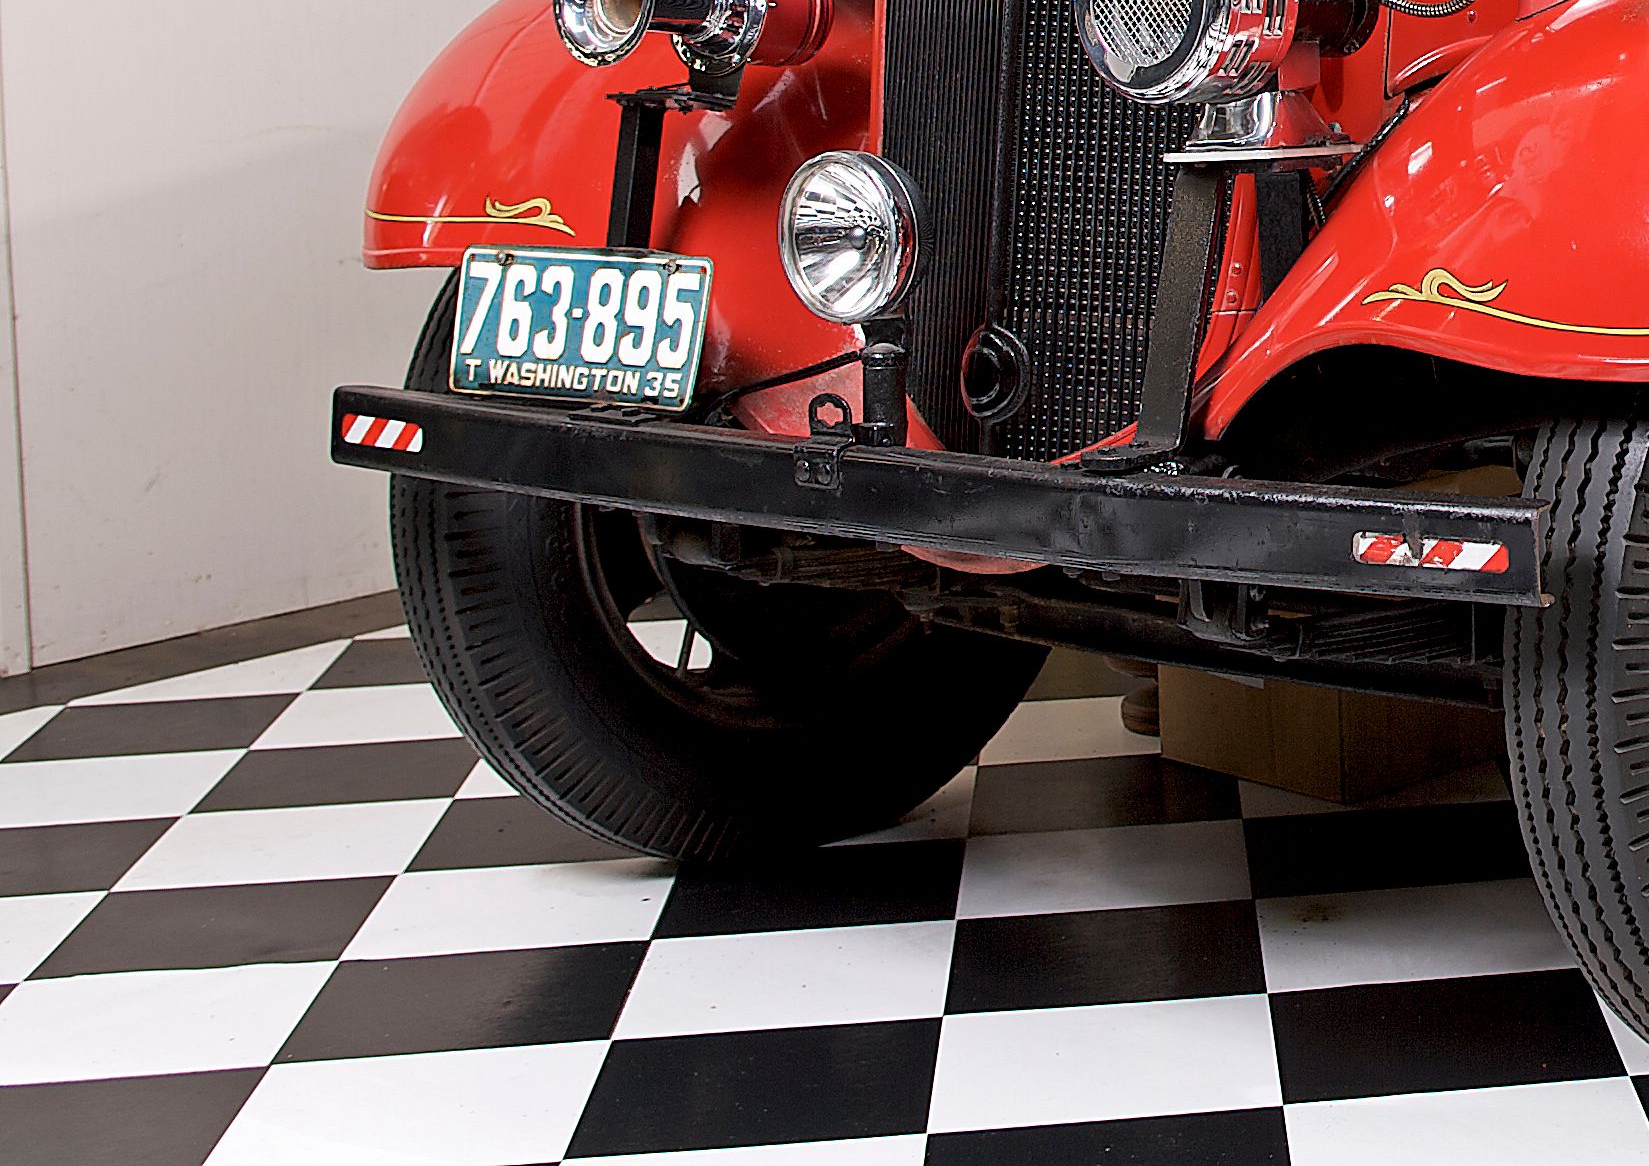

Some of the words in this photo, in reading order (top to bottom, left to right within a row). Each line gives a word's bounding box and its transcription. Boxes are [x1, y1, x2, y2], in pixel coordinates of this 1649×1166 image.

[460, 261, 701, 369] 763-895
[464, 358, 482, 382] T
[488, 359, 641, 395] WASHINGTON
[643, 372, 683, 398] 35
